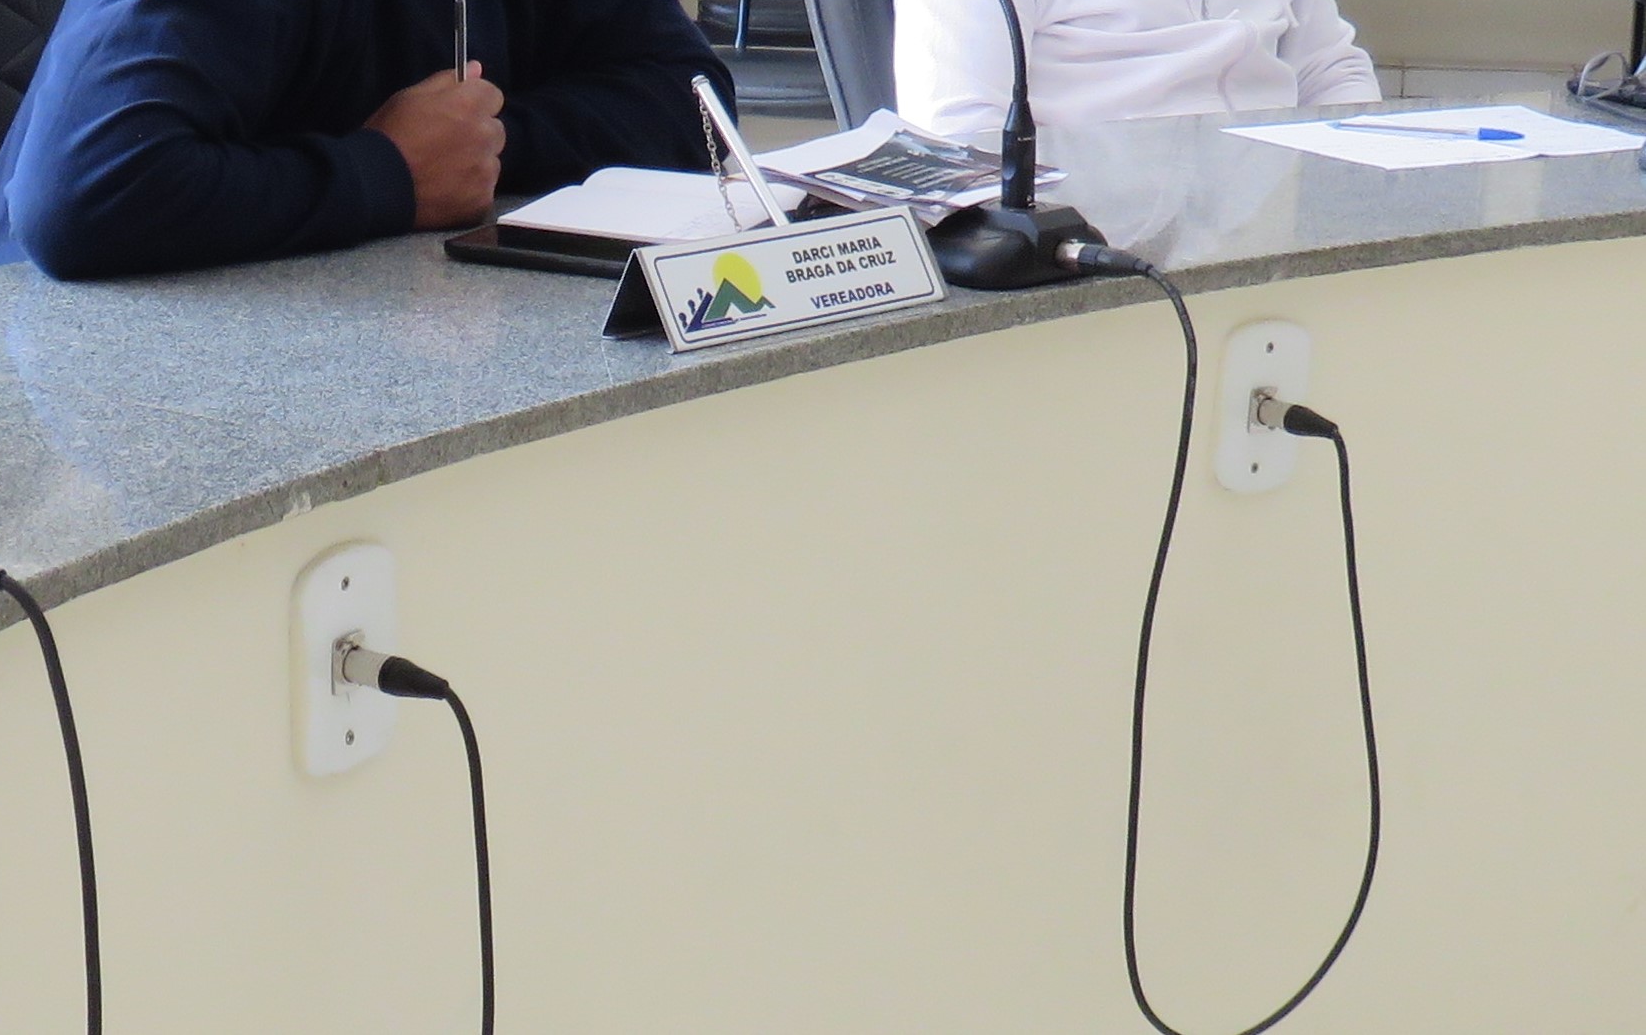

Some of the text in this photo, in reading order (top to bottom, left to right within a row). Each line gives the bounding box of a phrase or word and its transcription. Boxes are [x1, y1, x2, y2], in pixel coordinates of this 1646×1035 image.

[792, 236, 882, 264] DARCI MARIA
[785, 251, 897, 283] BRAGA DA CRUZ
[810, 282, 895, 309] VEREADORA
